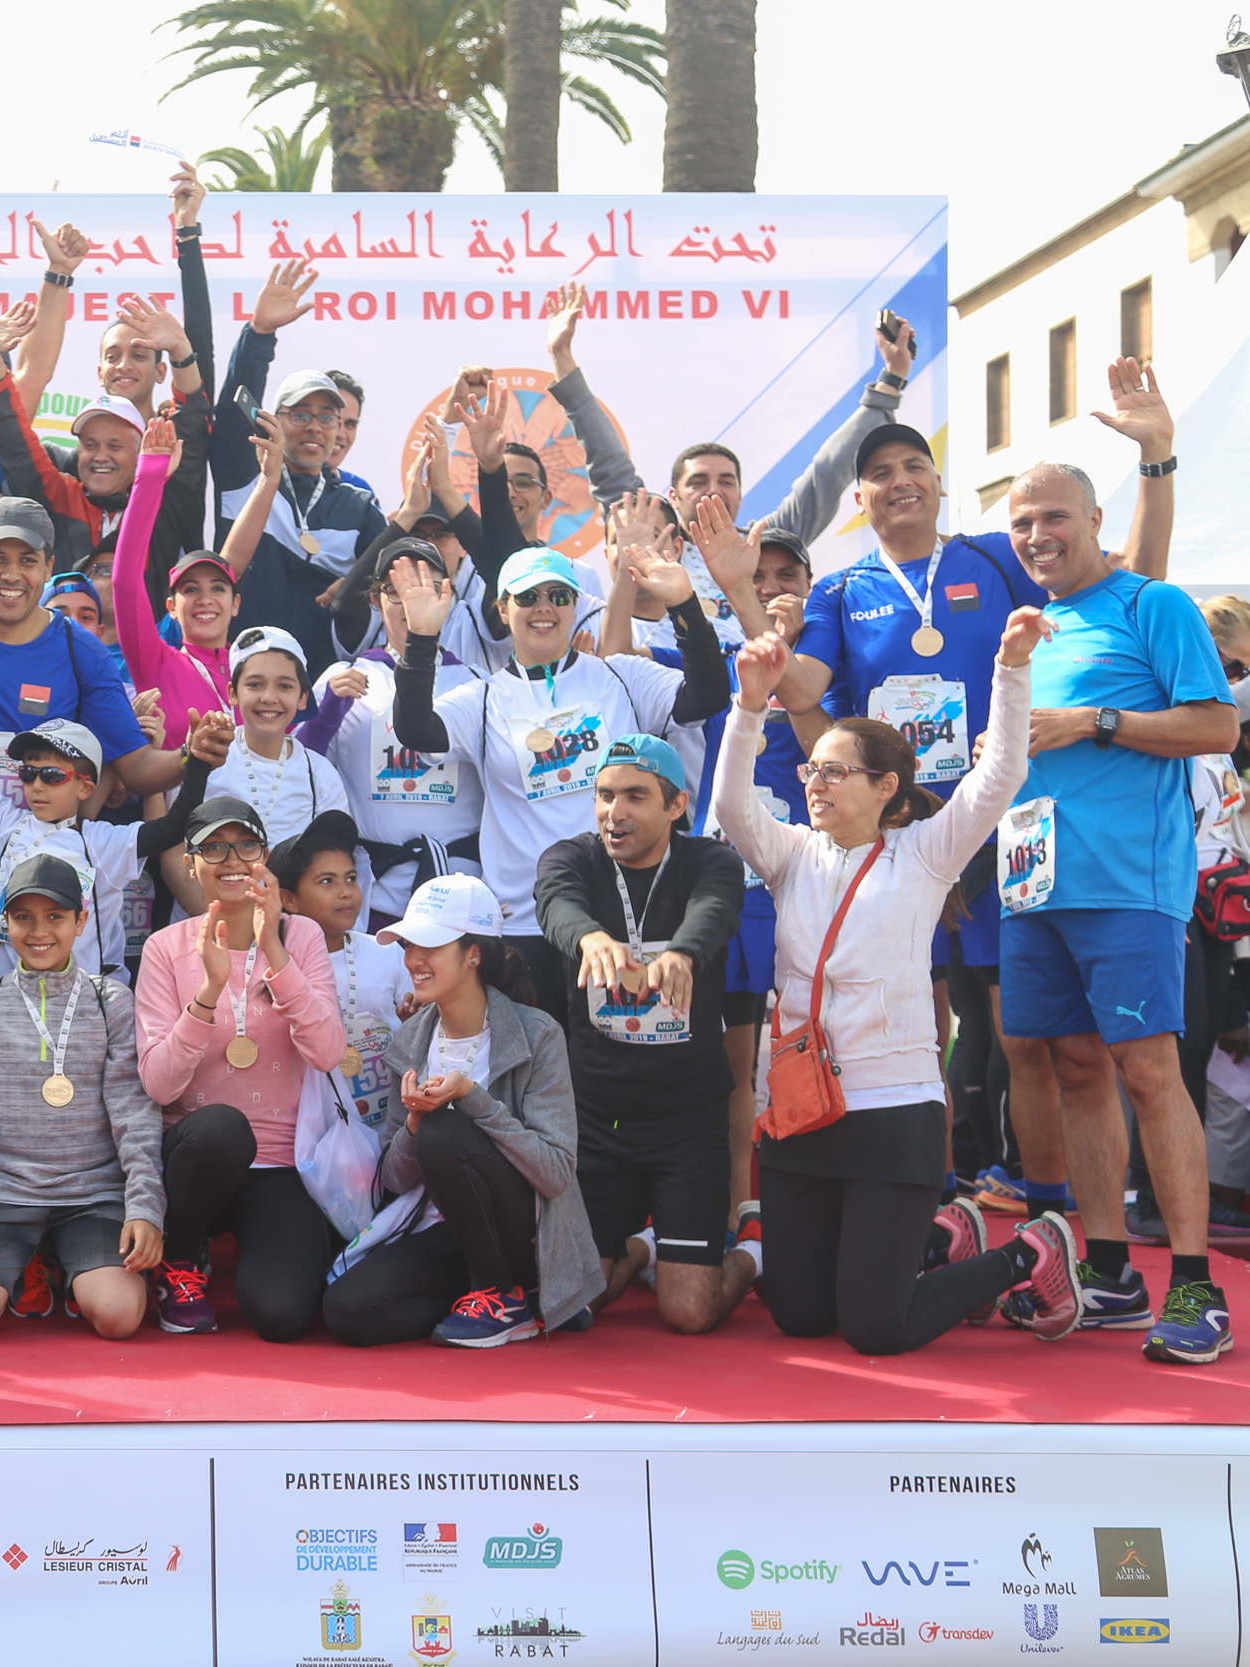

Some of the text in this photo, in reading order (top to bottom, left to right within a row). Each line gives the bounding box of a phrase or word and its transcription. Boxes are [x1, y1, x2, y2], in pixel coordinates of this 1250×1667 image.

[668, 224, 778, 264] تحت
[313, 291, 398, 321] ROI
[742, 289, 790, 319] VI
[899, 719, 956, 747] 054
[1006, 838, 1047, 875] 1013
[658, 1022, 684, 1031] MDJS
[630, 1034, 648, 1042] 2019
[285, 1472, 580, 1491] PARTENAIRES INSTITUTIONNELS
[890, 1475, 1016, 1493] PARTENAIRES
[296, 1529, 378, 1543] OBJECTIFS
[297, 1544, 377, 1554] DE DÉVELOPPEMENT
[490, 1541, 557, 1560] MDJS
[43, 1562, 148, 1572] LESIEUR CRISTAL
[296, 1555, 378, 1571] DURABLE
[760, 1559, 839, 1584] Spotify
[120, 1575, 148, 1586] Avril
[1002, 1582, 1077, 1597] Mega Mall
[491, 1607, 567, 1619] VISIT
[857, 1611, 899, 1630] ريضال
[840, 1627, 905, 1646] Redal
[941, 1627, 995, 1641] transdev
[1110, 1626, 1163, 1637] IKEA
[717, 1631, 772, 1651] Langages
[774, 1632, 794, 1645] du
[1020, 1643, 1064, 1654] Unilever
[495, 1644, 569, 1658] RABAT
